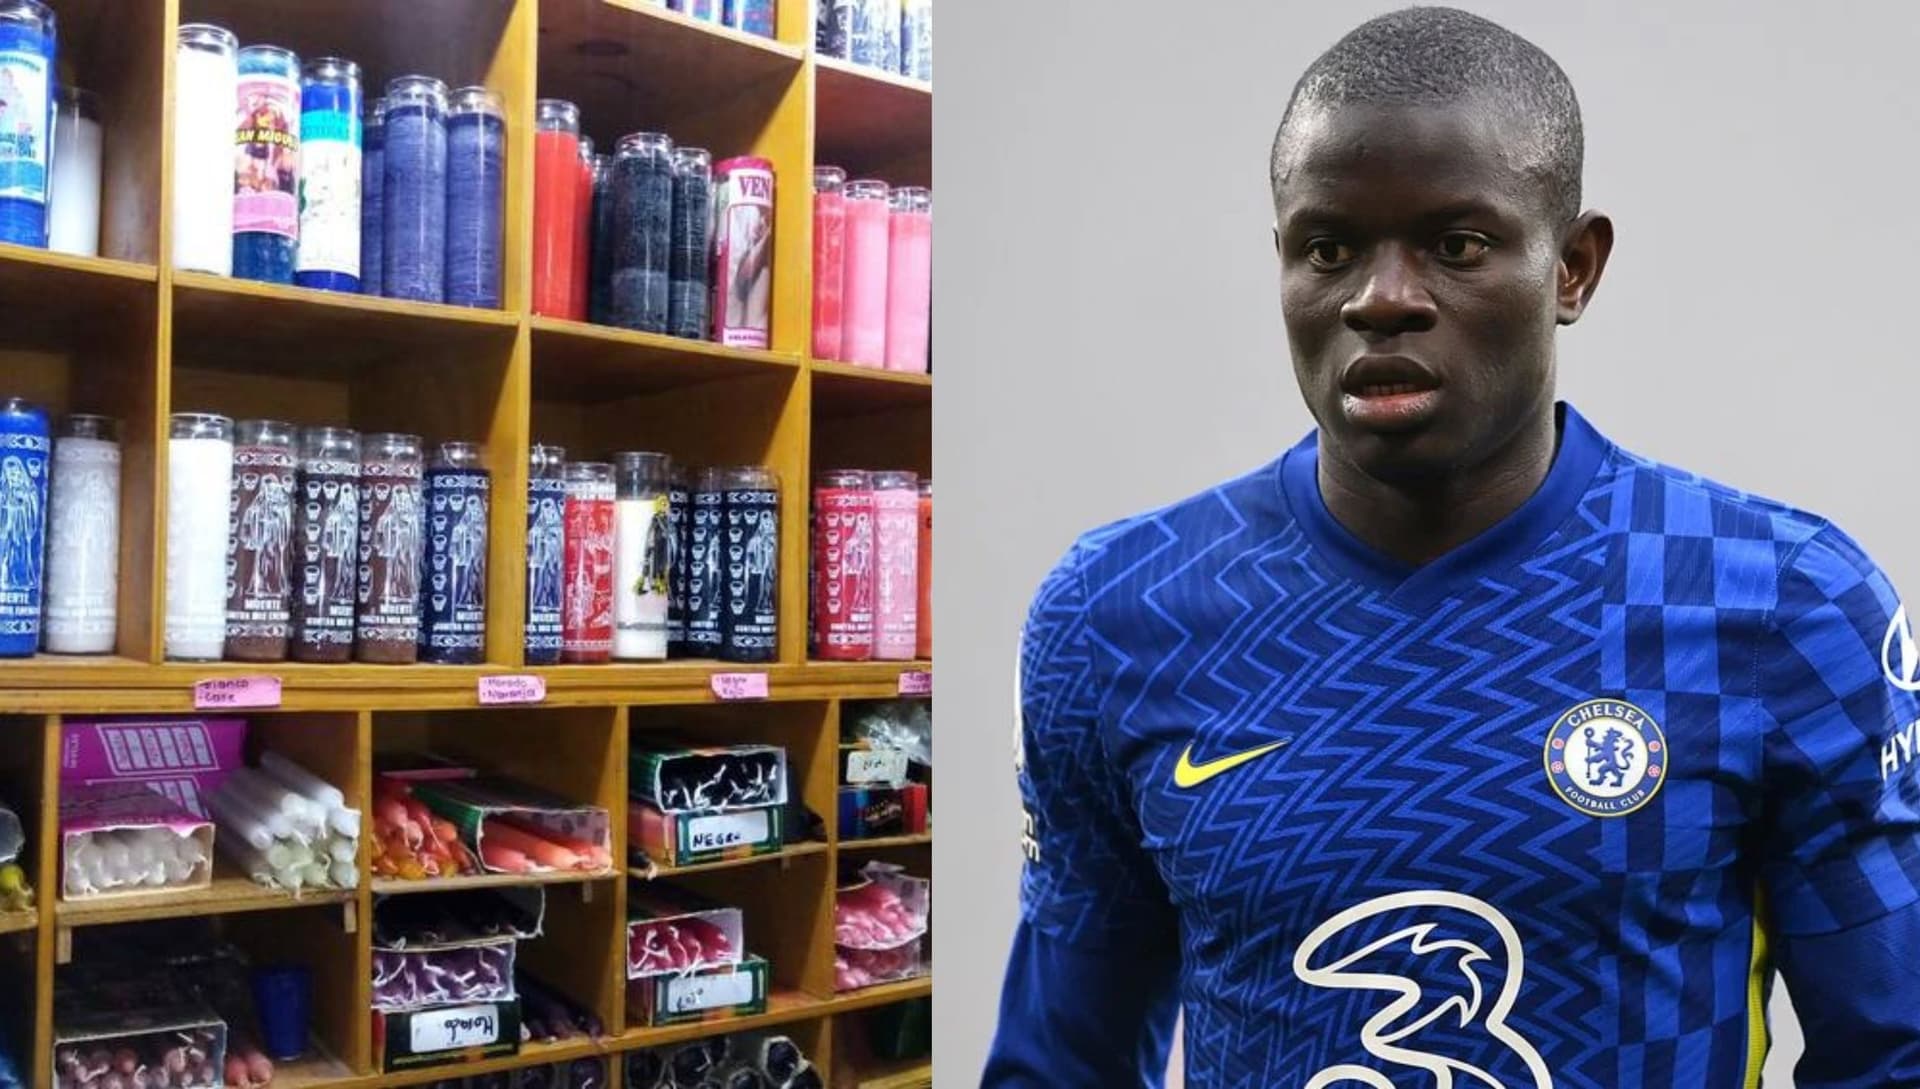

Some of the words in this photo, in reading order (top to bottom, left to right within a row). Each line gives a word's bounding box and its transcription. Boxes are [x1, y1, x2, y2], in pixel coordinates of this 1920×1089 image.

[1567, 703, 1646, 730] CHELSEA
[1565, 786, 1616, 810] FOOTBALL
[1620, 789, 1645, 807] CLUB
